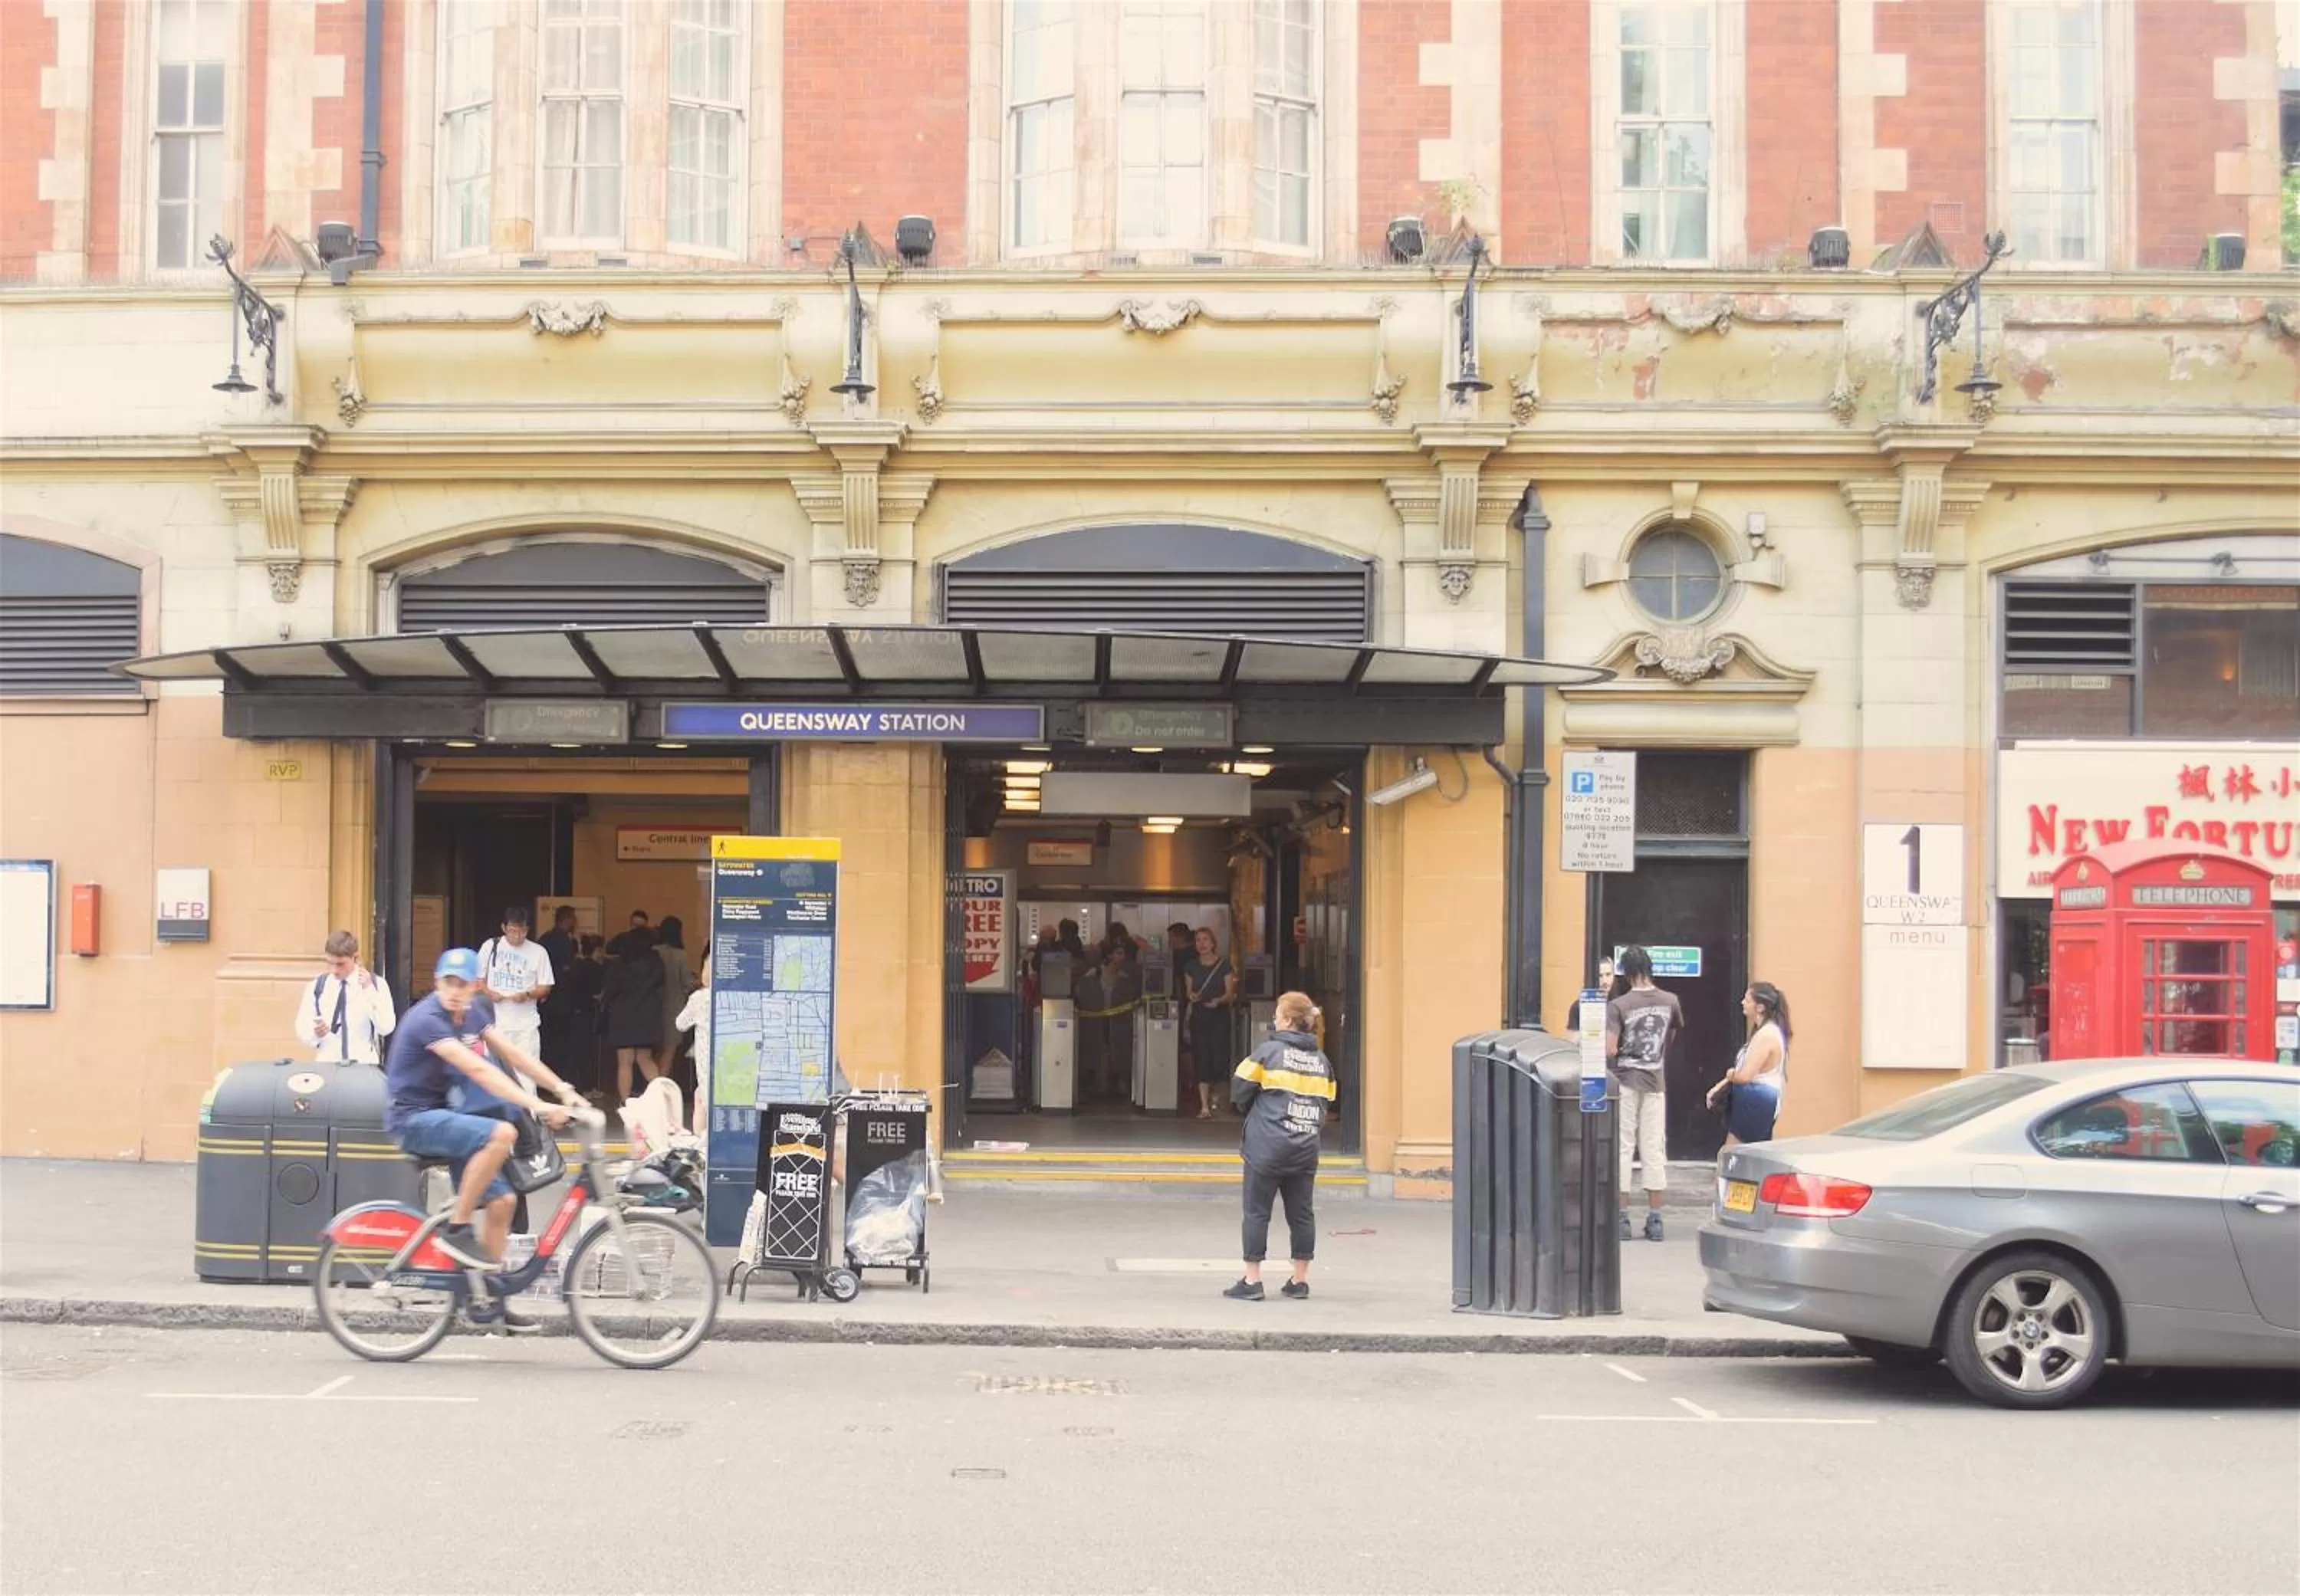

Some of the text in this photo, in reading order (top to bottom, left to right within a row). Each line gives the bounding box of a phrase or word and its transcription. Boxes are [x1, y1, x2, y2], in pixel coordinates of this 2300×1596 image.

[740, 712, 966, 731] QUEENSWAY STATION
[1134, 725, 1151, 737] Do
[1153, 726, 1175, 737] not
[268, 764, 298, 777] RVP
[1598, 773, 1612, 783] Pay
[649, 833, 688, 844] Central
[2027, 803, 2300, 859] NEW FORTU
[1898, 825, 1921, 895] 1
[1865, 895, 1962, 909] QUEENSWA
[2138, 888, 2249, 904] TELEPHONE
[160, 901, 205, 919] LFB
[962, 900, 1002, 912] OUR
[964, 914, 1002, 933] REE
[964, 938, 1001, 950] OPY
[1889, 931, 1946, 944] menu
[867, 1121, 906, 1138] FREE
[776, 1172, 818, 1190] FREE
